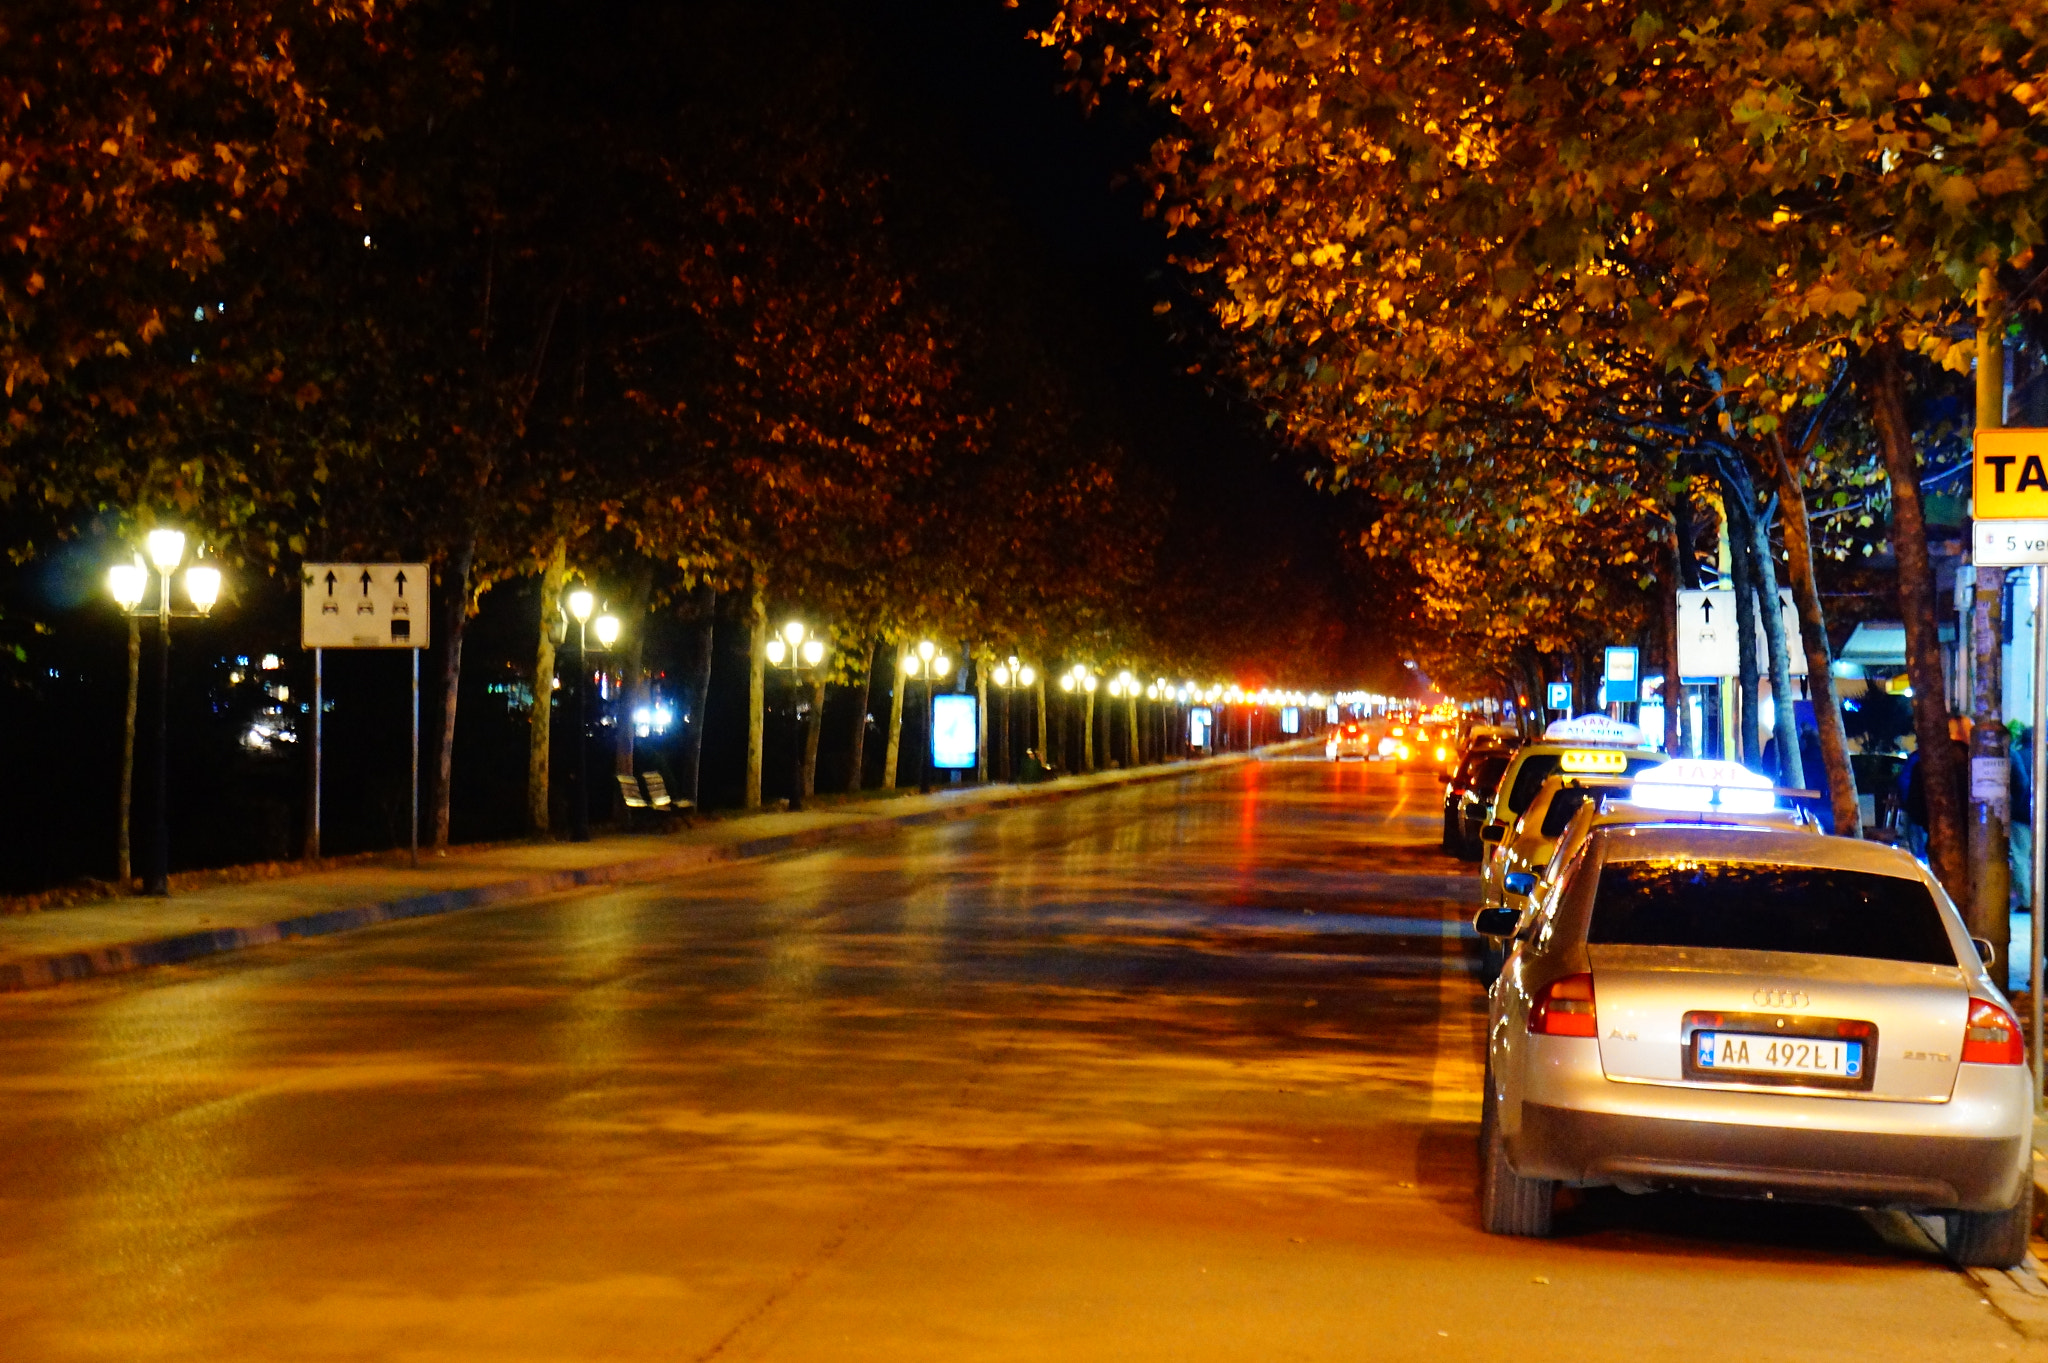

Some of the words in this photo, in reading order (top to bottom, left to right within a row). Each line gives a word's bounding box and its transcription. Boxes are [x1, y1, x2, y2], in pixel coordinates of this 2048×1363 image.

[2007, 536, 2017, 552] 5
[2025, 539, 2048, 552] ve
[1552, 685, 1568, 708] P
[1582, 717, 1611, 729] TAXI
[1677, 765, 1736, 780] TAXI
[1722, 1039, 1750, 1065] AA
